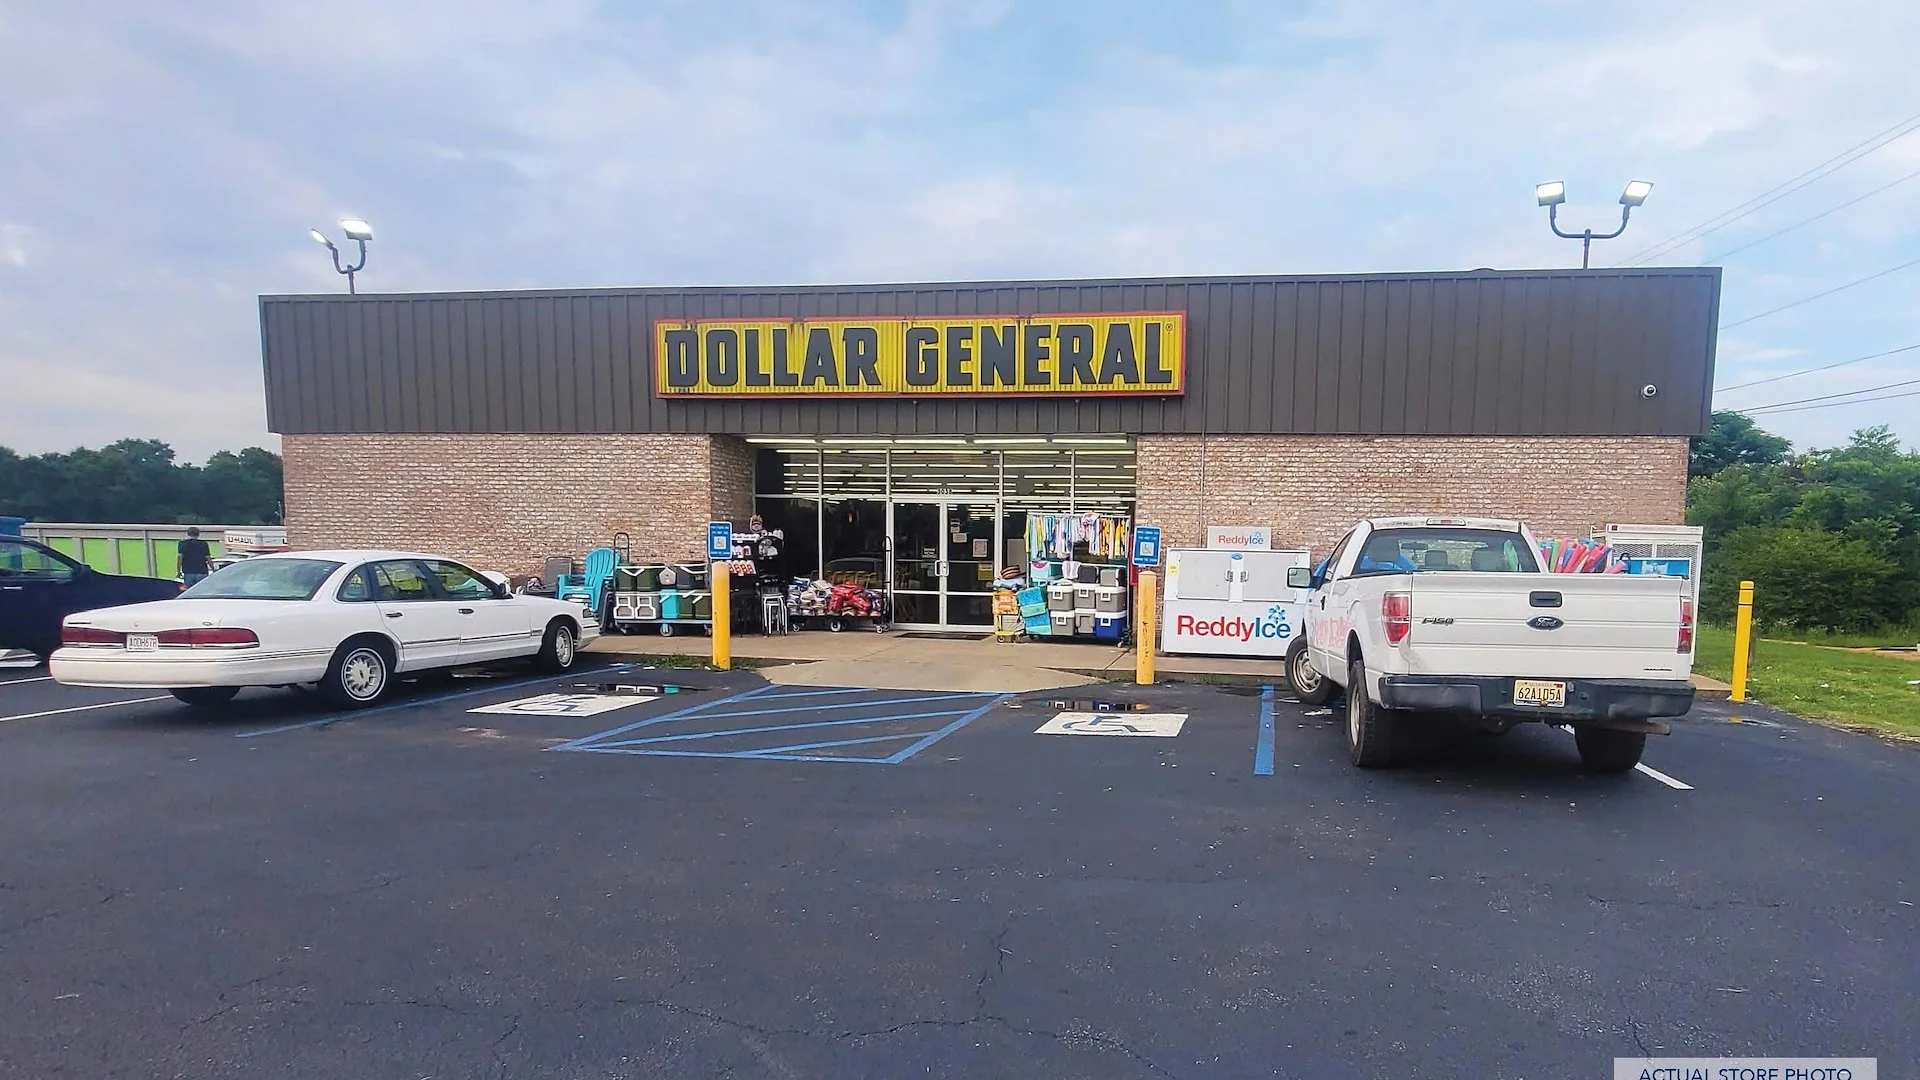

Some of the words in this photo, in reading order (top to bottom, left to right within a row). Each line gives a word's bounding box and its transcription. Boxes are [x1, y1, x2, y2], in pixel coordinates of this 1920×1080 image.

[664, 328, 882, 387] DOLLAR
[905, 322, 1173, 385] GENERAL
[1218, 534, 1264, 546] ReddyIce
[1177, 615, 1292, 642] ReddyIce
[1535, 617, 1558, 627] Ford
